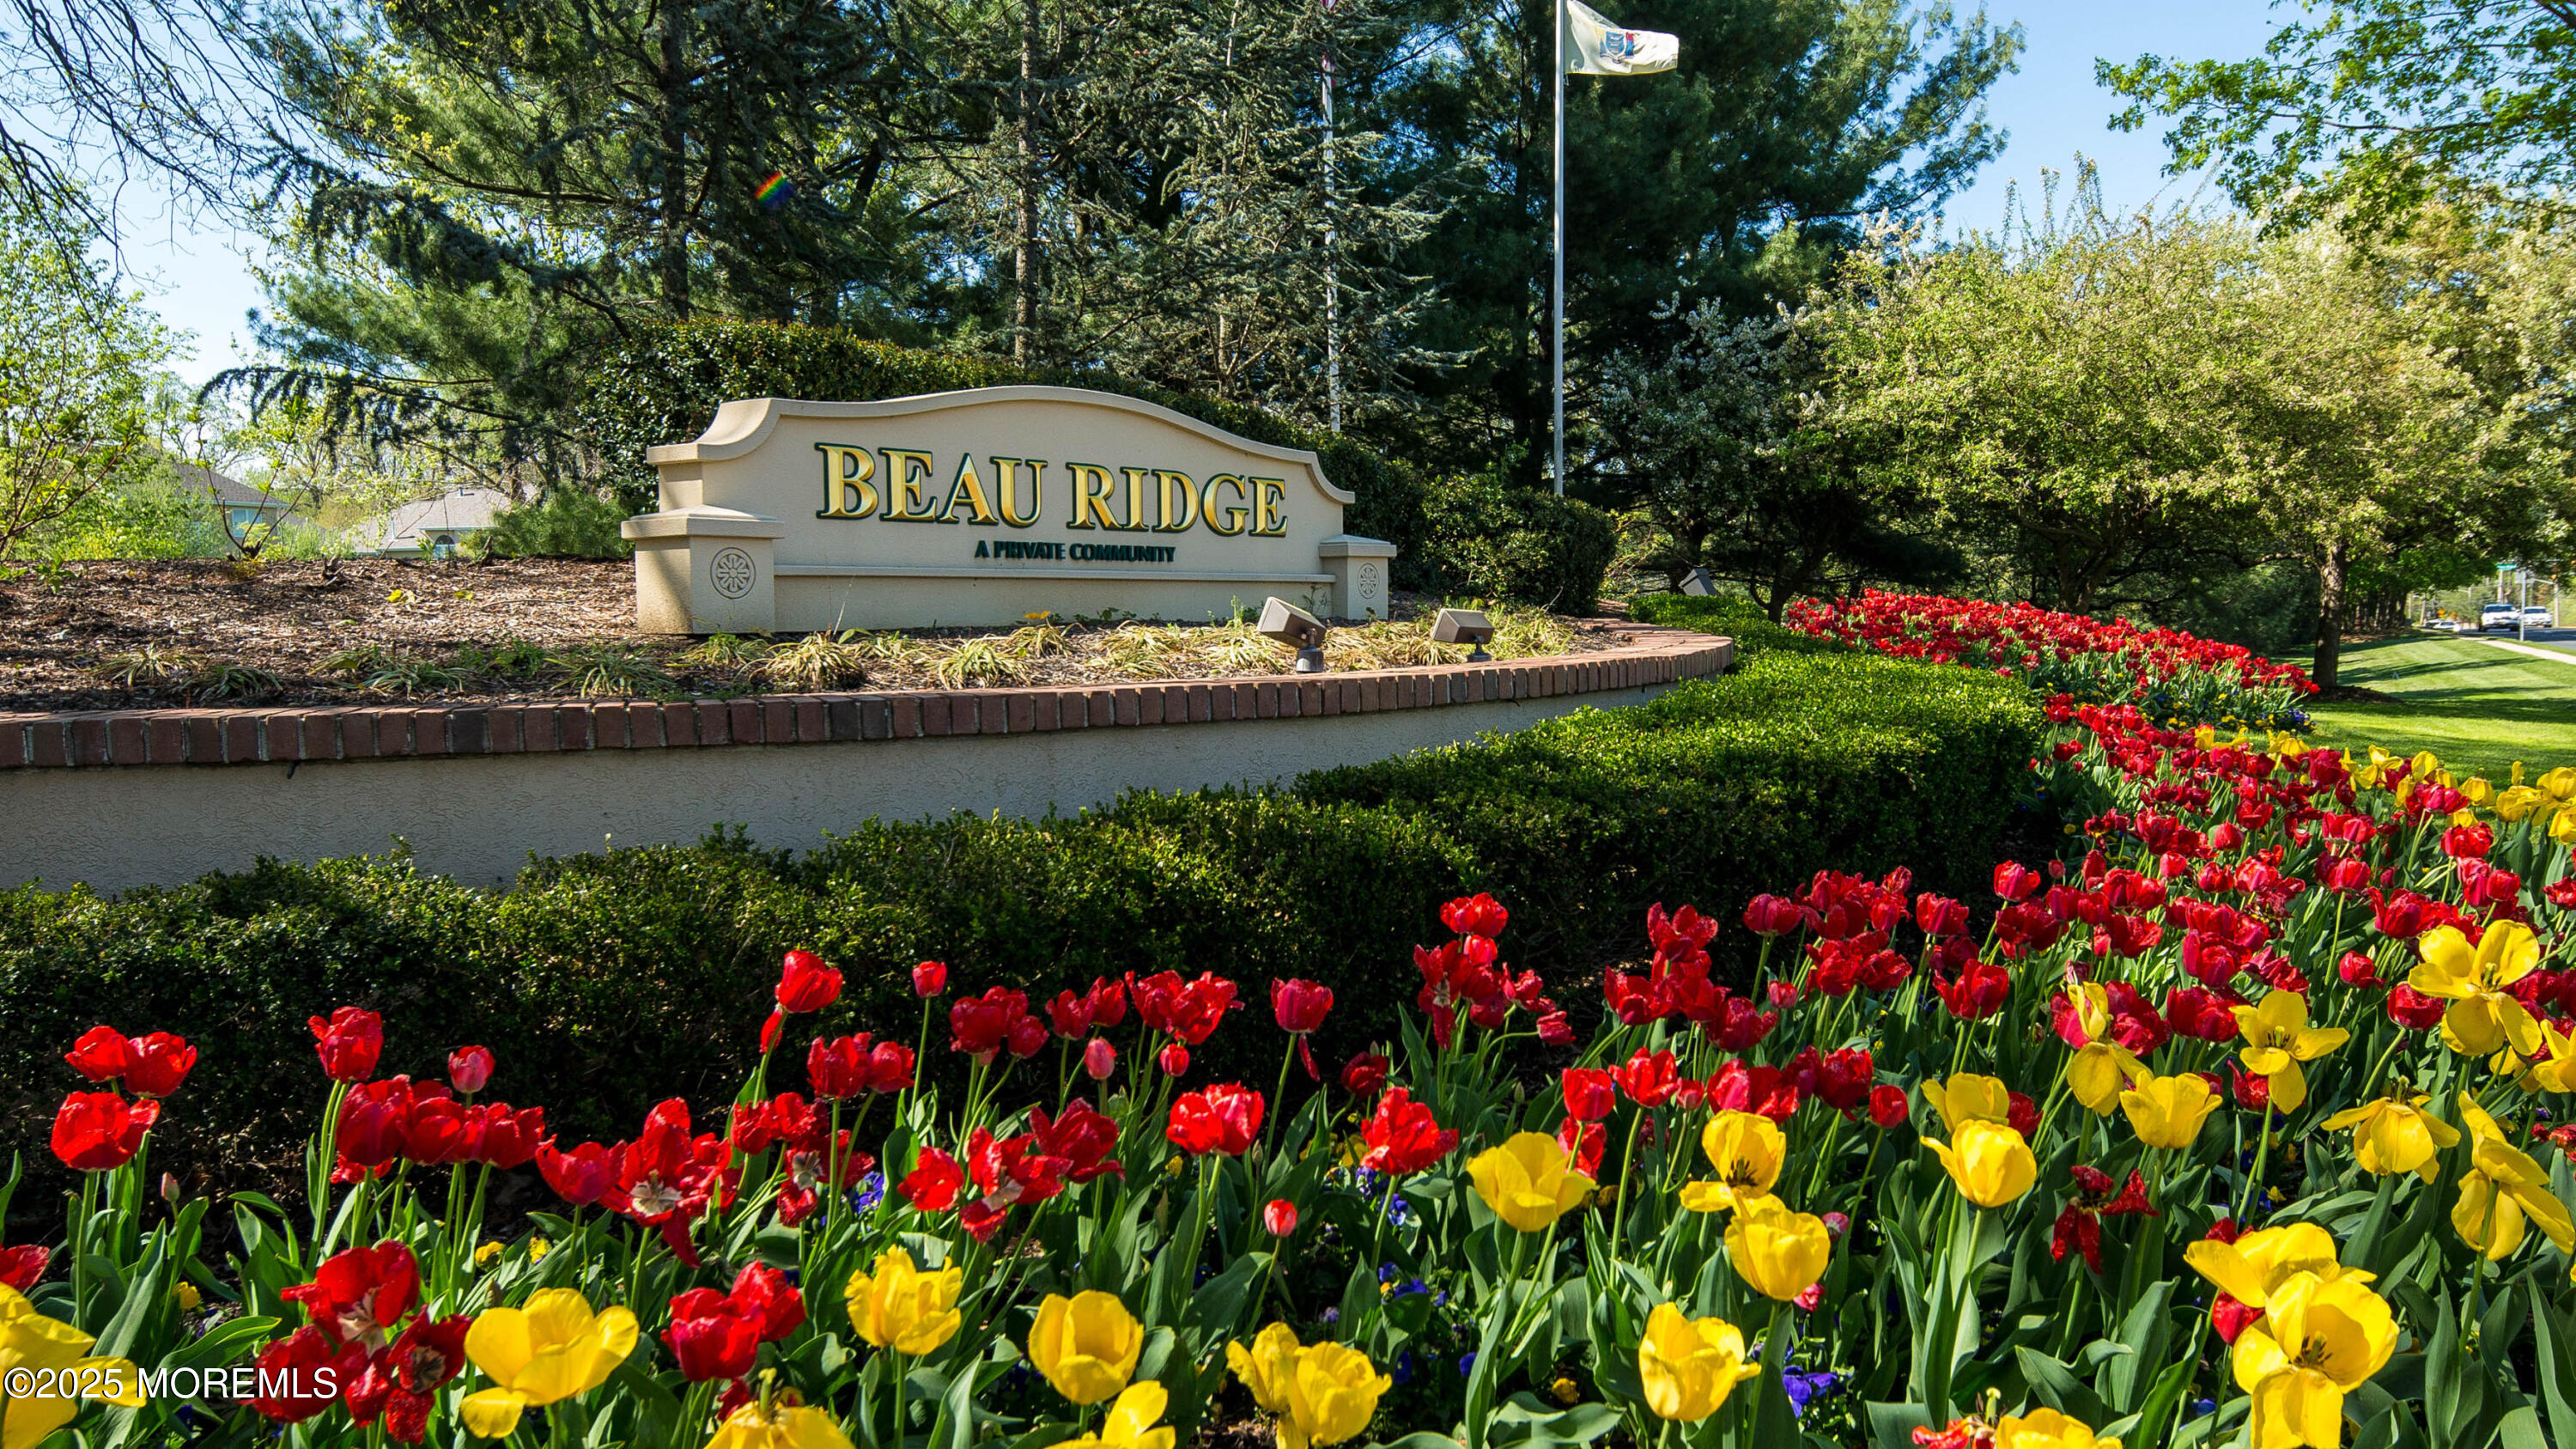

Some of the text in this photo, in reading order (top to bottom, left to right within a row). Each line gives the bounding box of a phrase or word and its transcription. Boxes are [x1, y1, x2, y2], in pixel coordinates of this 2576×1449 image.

[814, 442, 1288, 537] BEAU RIDGE
[975, 540, 1176, 563] A PRIVATE COMMUNITY
